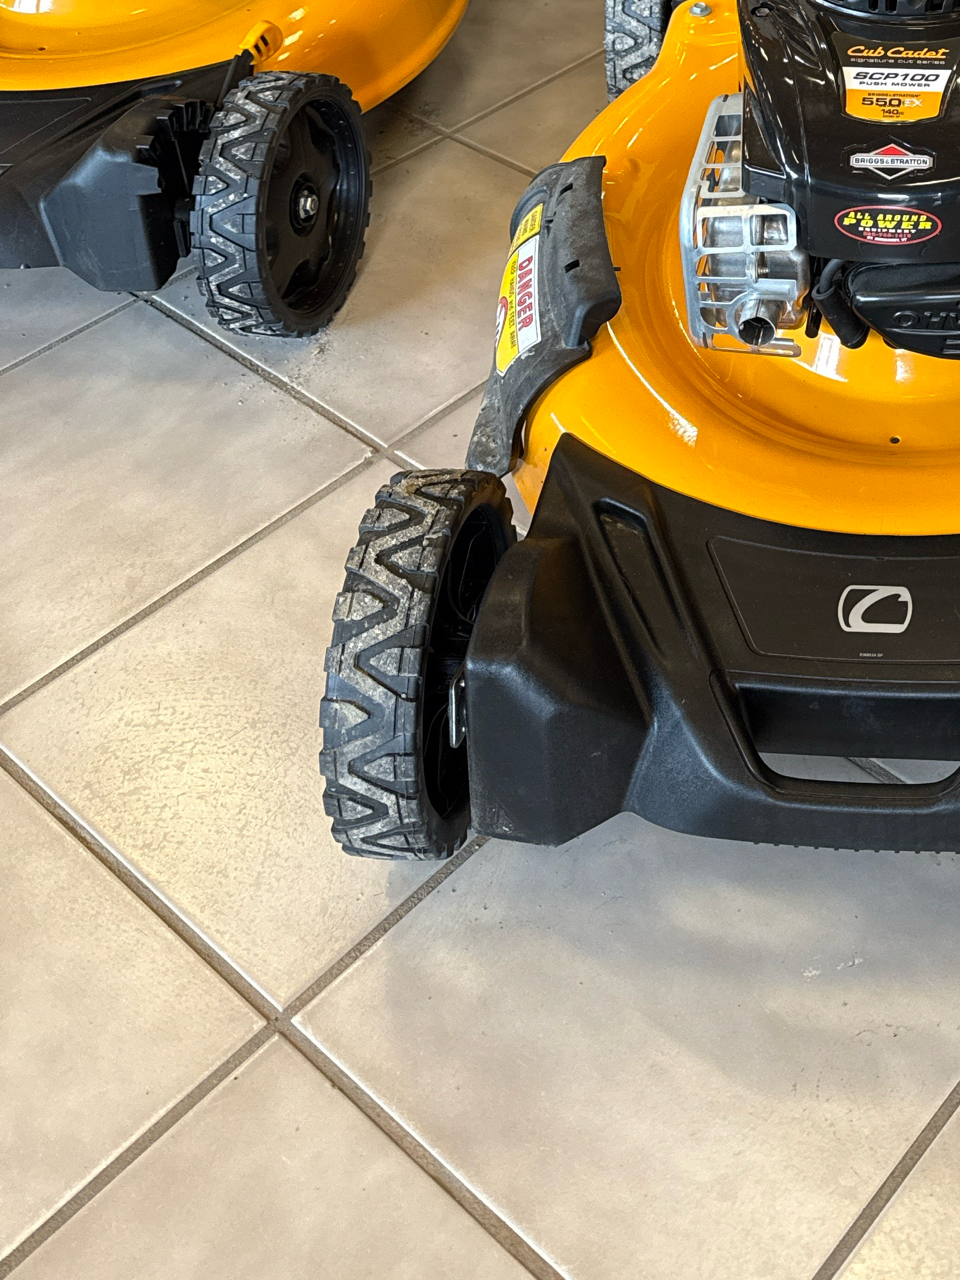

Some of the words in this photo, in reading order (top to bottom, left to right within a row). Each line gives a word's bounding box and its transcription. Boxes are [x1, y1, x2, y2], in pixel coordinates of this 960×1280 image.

[847, 45, 885, 57] Cub
[887, 47, 950, 58] Cadet
[853, 71, 941, 82] SCP100
[848, 211, 871, 220] ALL
[876, 213, 928, 222] AROUND
[843, 217, 933, 229] POWER
[858, 226, 917, 234] EQUIPMENT
[517, 255, 534, 332] DANGER
